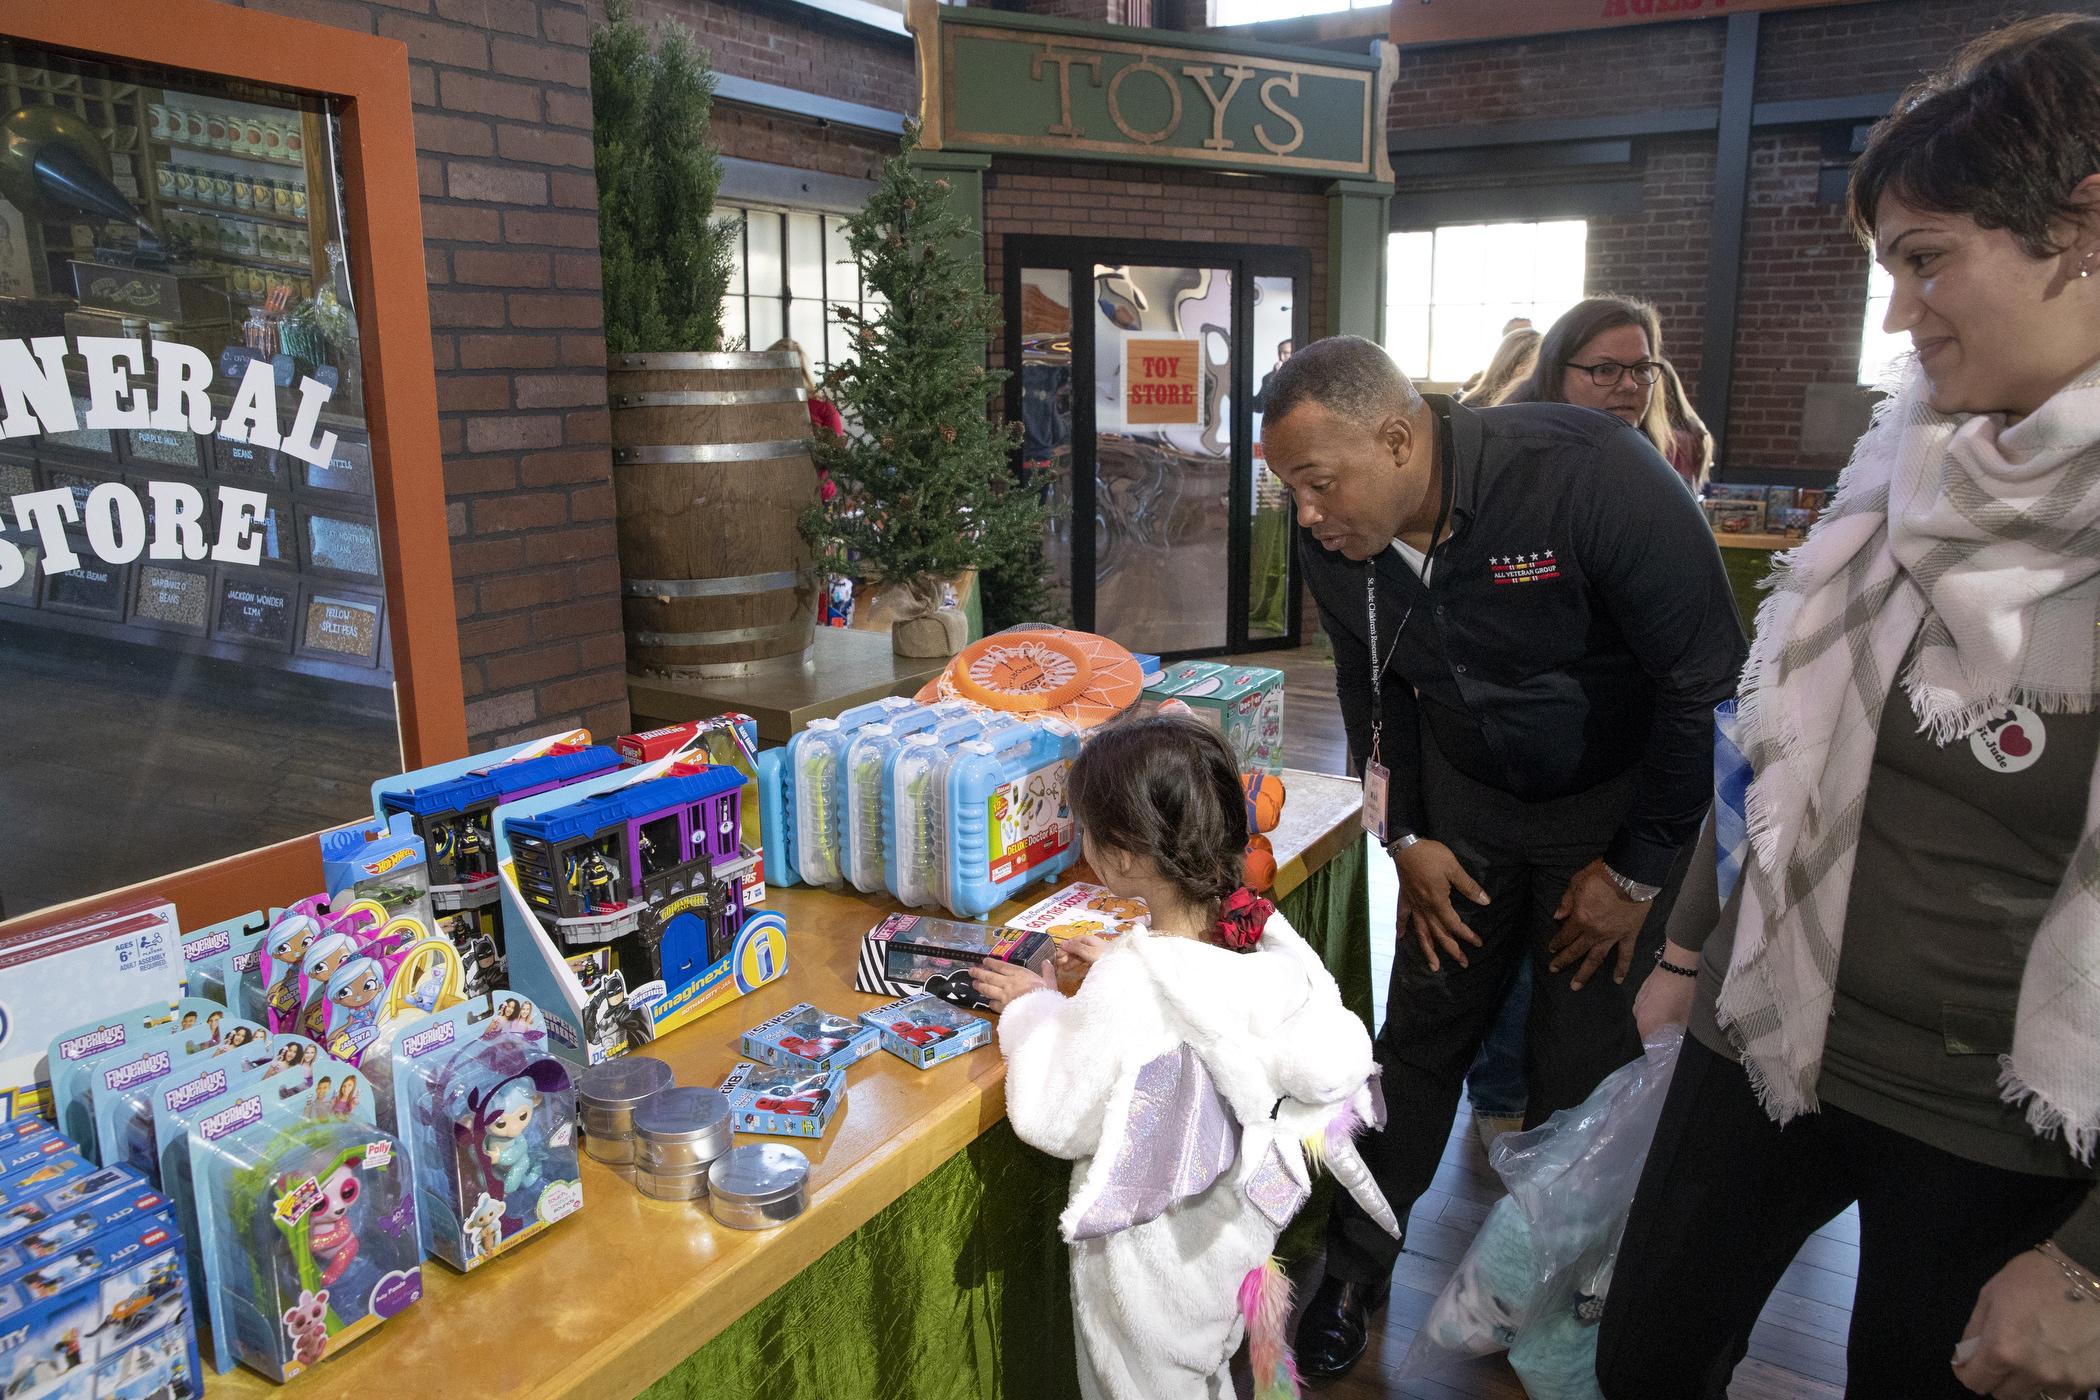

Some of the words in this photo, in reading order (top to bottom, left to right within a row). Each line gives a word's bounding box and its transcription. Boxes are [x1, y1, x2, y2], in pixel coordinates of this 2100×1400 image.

[1031, 51, 1304, 155] TOYS
[1142, 356, 1181, 379] TOY
[0, 336, 338, 469] NERAL
[1131, 383, 1195, 406] STORE
[232, 447, 254, 460] BEANS
[1506, 568, 1534, 578] VETERAN
[1535, 565, 1556, 575] GROUP
[227, 590, 255, 603] JACKSON
[256, 594, 284, 608] WONDER
[1367, 587, 1376, 602] Jude
[1371, 636, 1379, 665] Research
[1985, 741, 2008, 769] Jude
[1007, 840, 1028, 857] DELUXE
[741, 872, 757, 885] ERS
[114, 941, 134, 952] AGES
[119, 961, 137, 972] ADULT
[138, 953, 166, 967] ASSEMBLY
[653, 959, 731, 1018] imaginext
[339, 1030, 372, 1051] JASCENTA
[592, 1048, 606, 1064] DC
[367, 1141, 390, 1155] Polly
